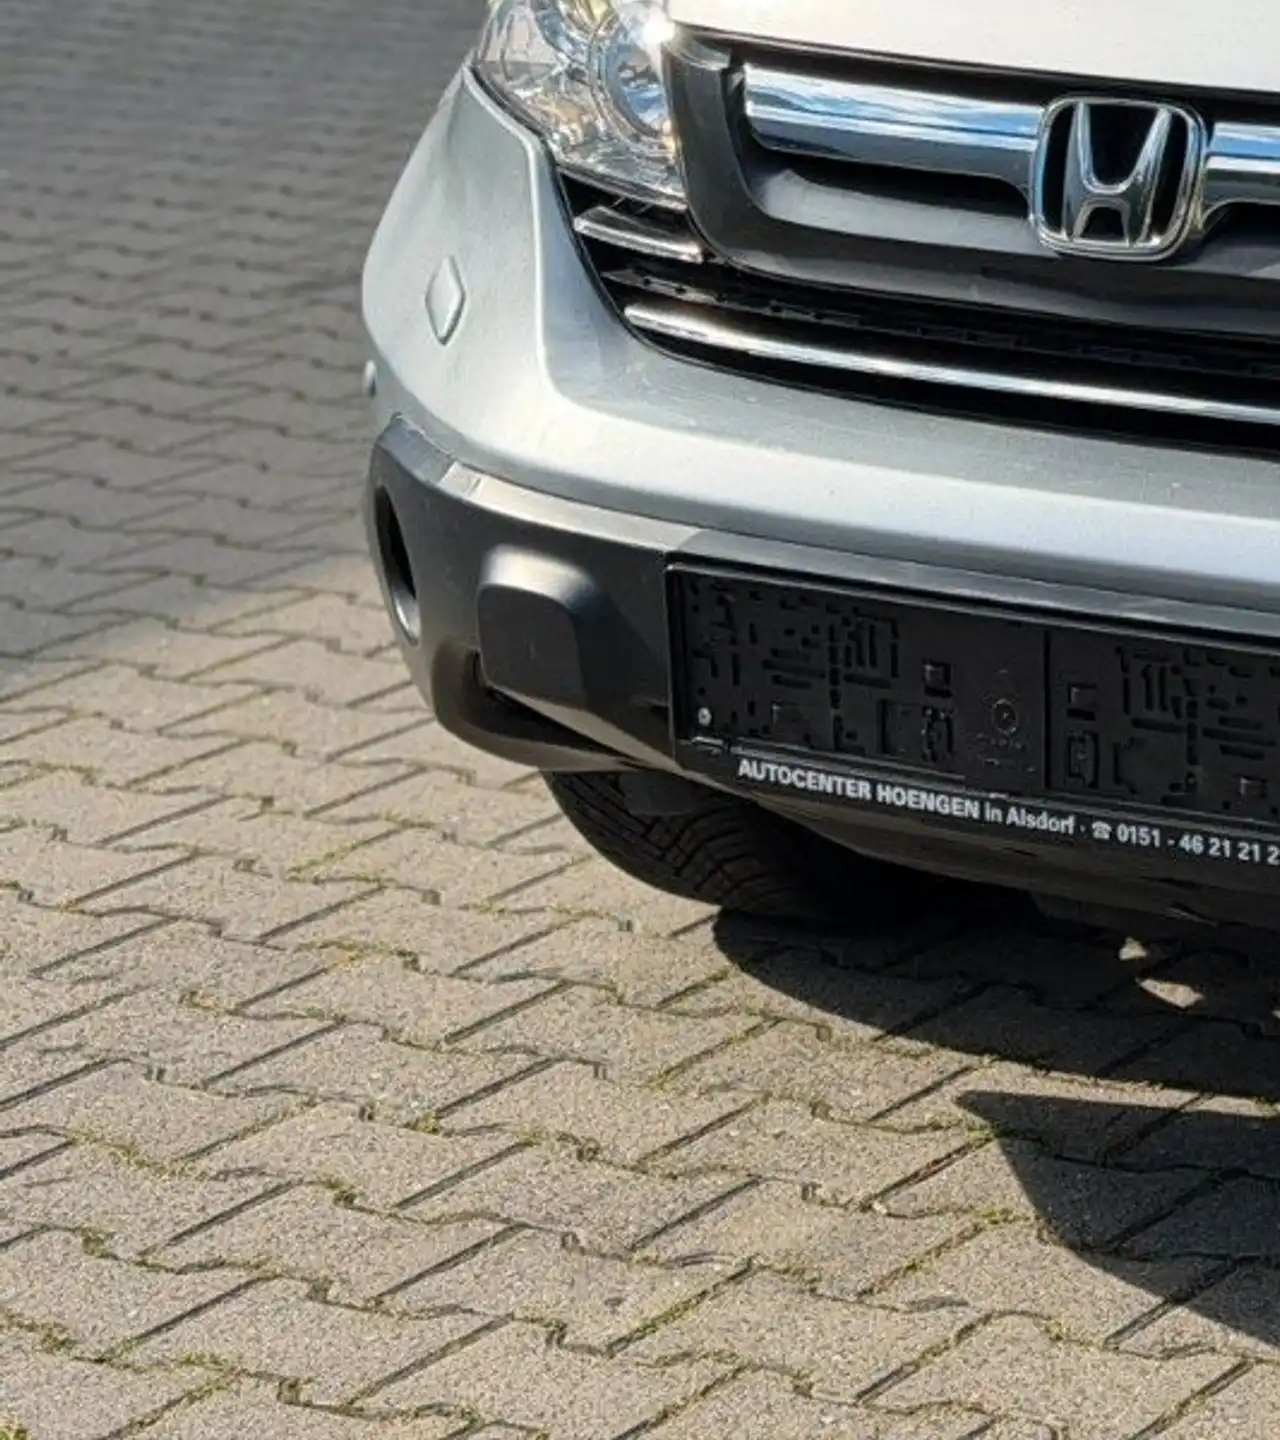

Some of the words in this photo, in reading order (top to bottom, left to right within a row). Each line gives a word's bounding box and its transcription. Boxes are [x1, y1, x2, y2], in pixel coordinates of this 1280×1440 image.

[1057, 98, 1175, 250] H
[738, 758, 872, 801] AUTOCENTER
[876, 781, 981, 820] HOENGEN
[984, 800, 1003, 823] in
[1005, 805, 1076, 836] Alsdorf
[1116, 823, 1161, 848] 0151
[1179, 833, 1204, 854] 46
[1208, 836, 1231, 859] 21
[1237, 841, 1260, 863] 21
